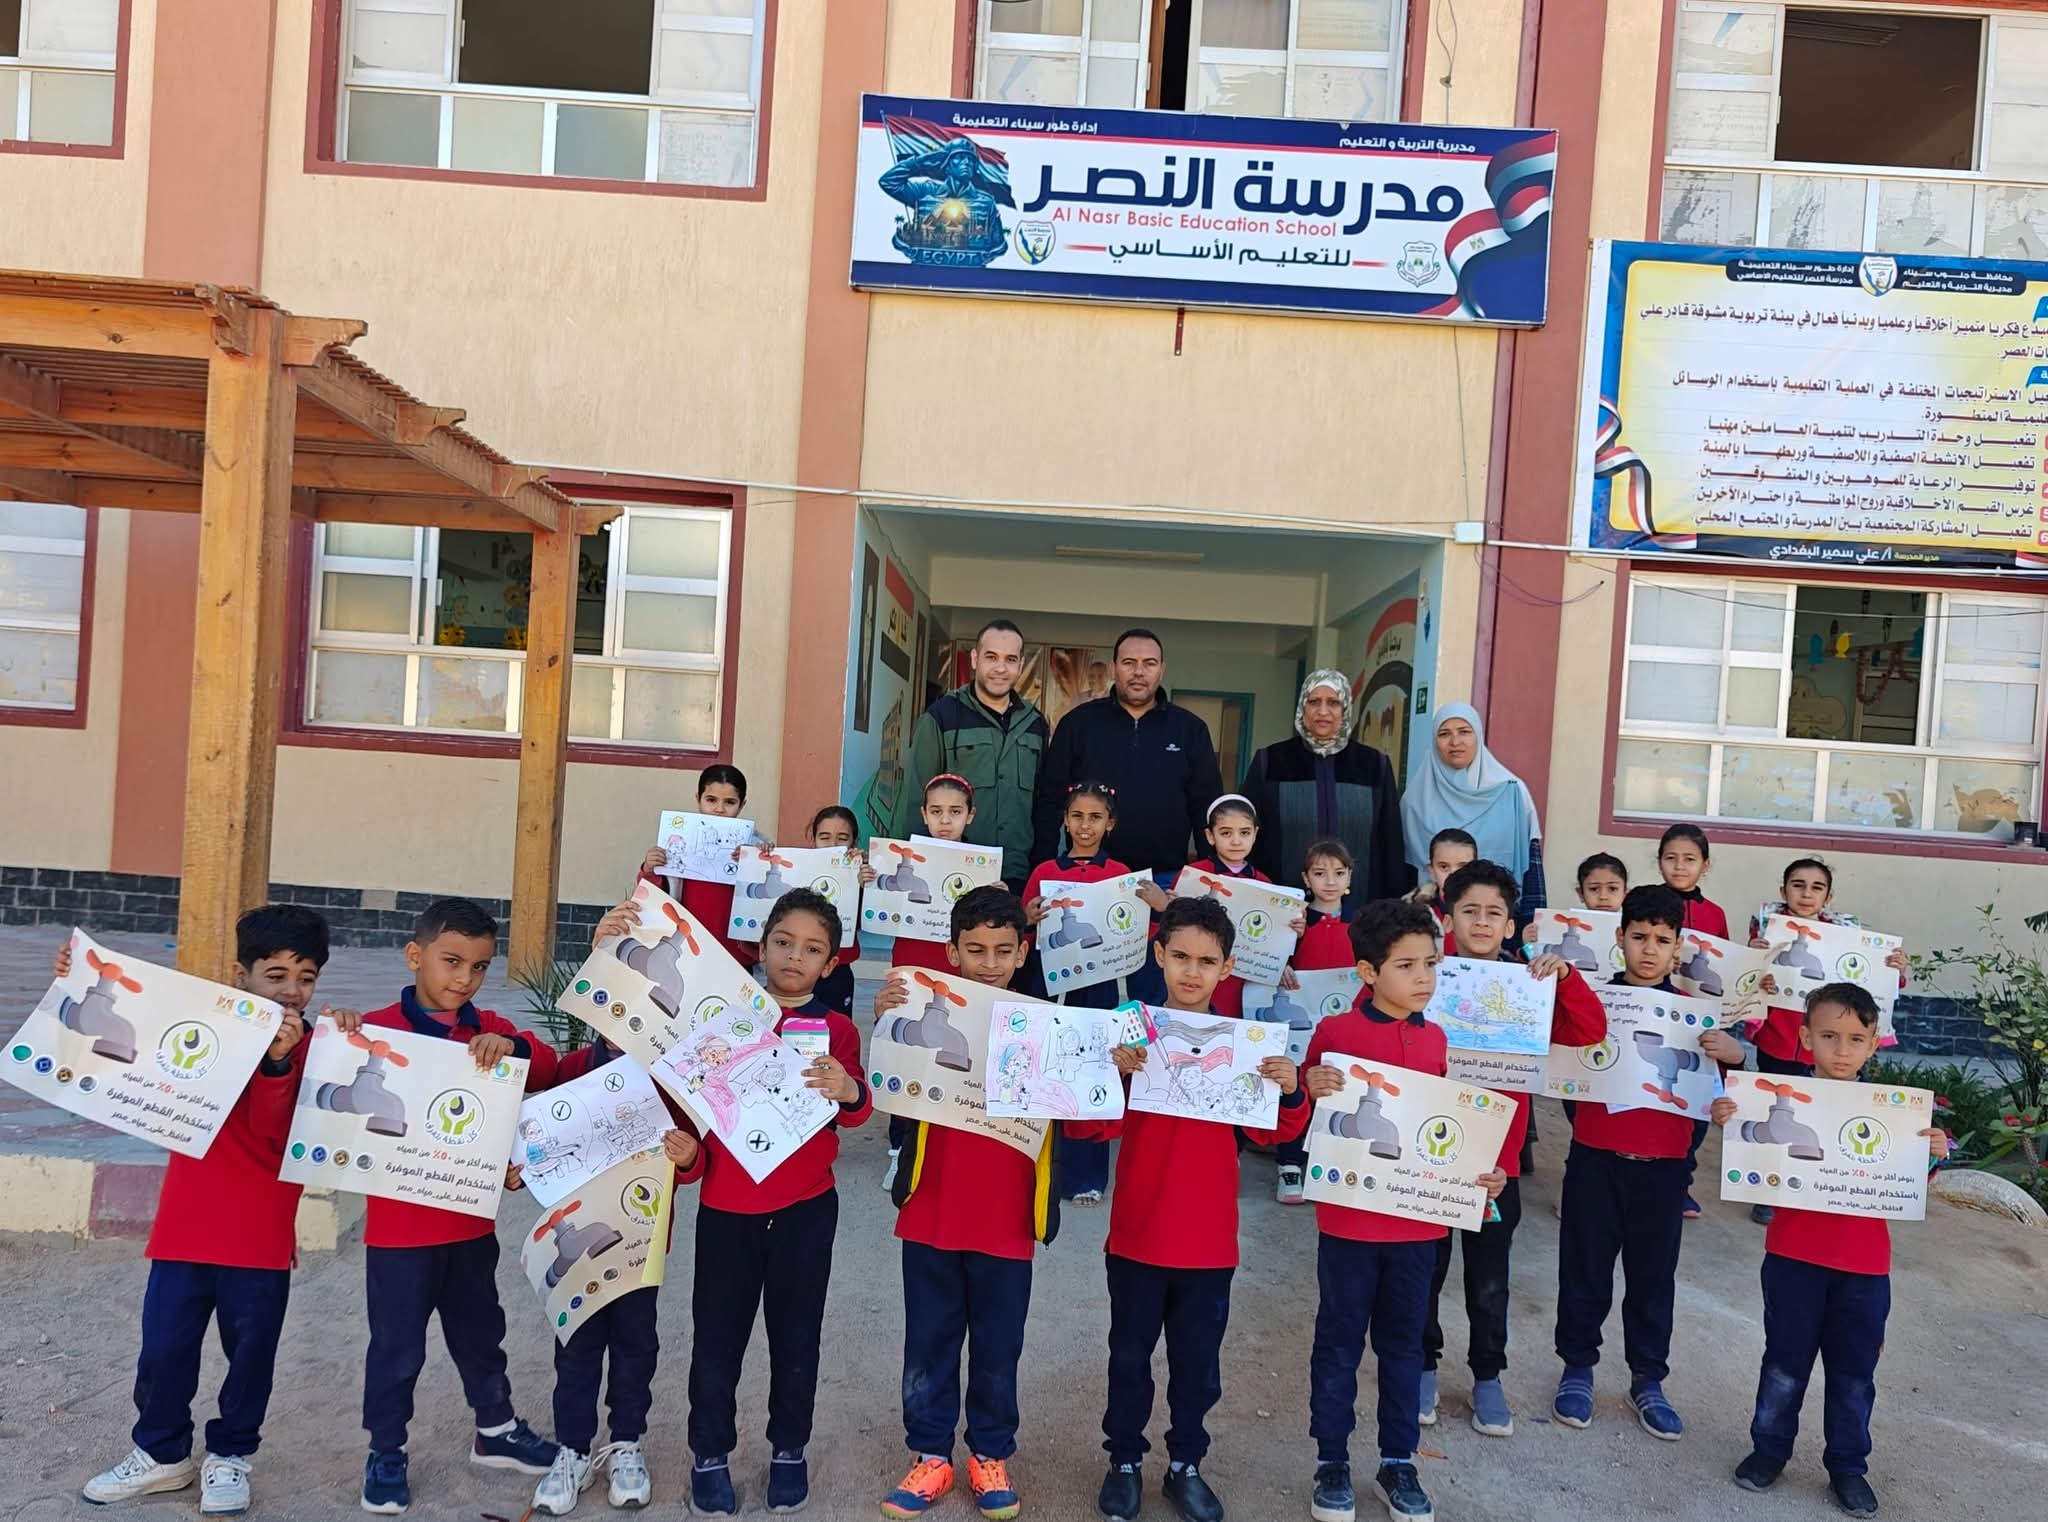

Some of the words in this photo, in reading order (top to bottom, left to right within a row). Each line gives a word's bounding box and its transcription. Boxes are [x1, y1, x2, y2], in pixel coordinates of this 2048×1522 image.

[952, 112, 1009, 128] التعليمية
[1010, 117, 1045, 130] سيناء
[1046, 120, 1070, 132] طور
[1071, 121, 1098, 135] إدارة
[1339, 136, 1387, 148] التعليم
[1388, 139, 1396, 150] و
[1397, 137, 1435, 151] التربية
[1436, 138, 1476, 153] مديرية
[1023, 156, 1216, 212] النصر
[1234, 160, 1464, 235] مدرسة
[1052, 207, 1071, 222] Al
[1078, 208, 1120, 225] Nasr
[1127, 210, 1174, 227] Basic
[1180, 214, 1270, 234] Education
[1274, 218, 1337, 238] School
[1108, 238, 1234, 263] الأساسي
[921, 250, 978, 265] EGYPT
[1238, 246, 1351, 268] للتعليم
[1738, 259, 1780, 270] التعليمية
[1781, 262, 1813, 271] سيناء
[1836, 264, 1855, 274] إدارة
[1804, 274, 1825, 283] النصر
[1903, 268, 1934, 277] سيناء
[1971, 271, 2014, 282] محافظة
[1825, 274, 1854, 285] مدرسة
[1902, 280, 1941, 289] التعليم
[1947, 281, 1983, 291] التربية
[1983, 283, 2013, 293] مديرية
[1797, 309, 1811, 330] في
[1820, 547, 1854, 559] سمير
